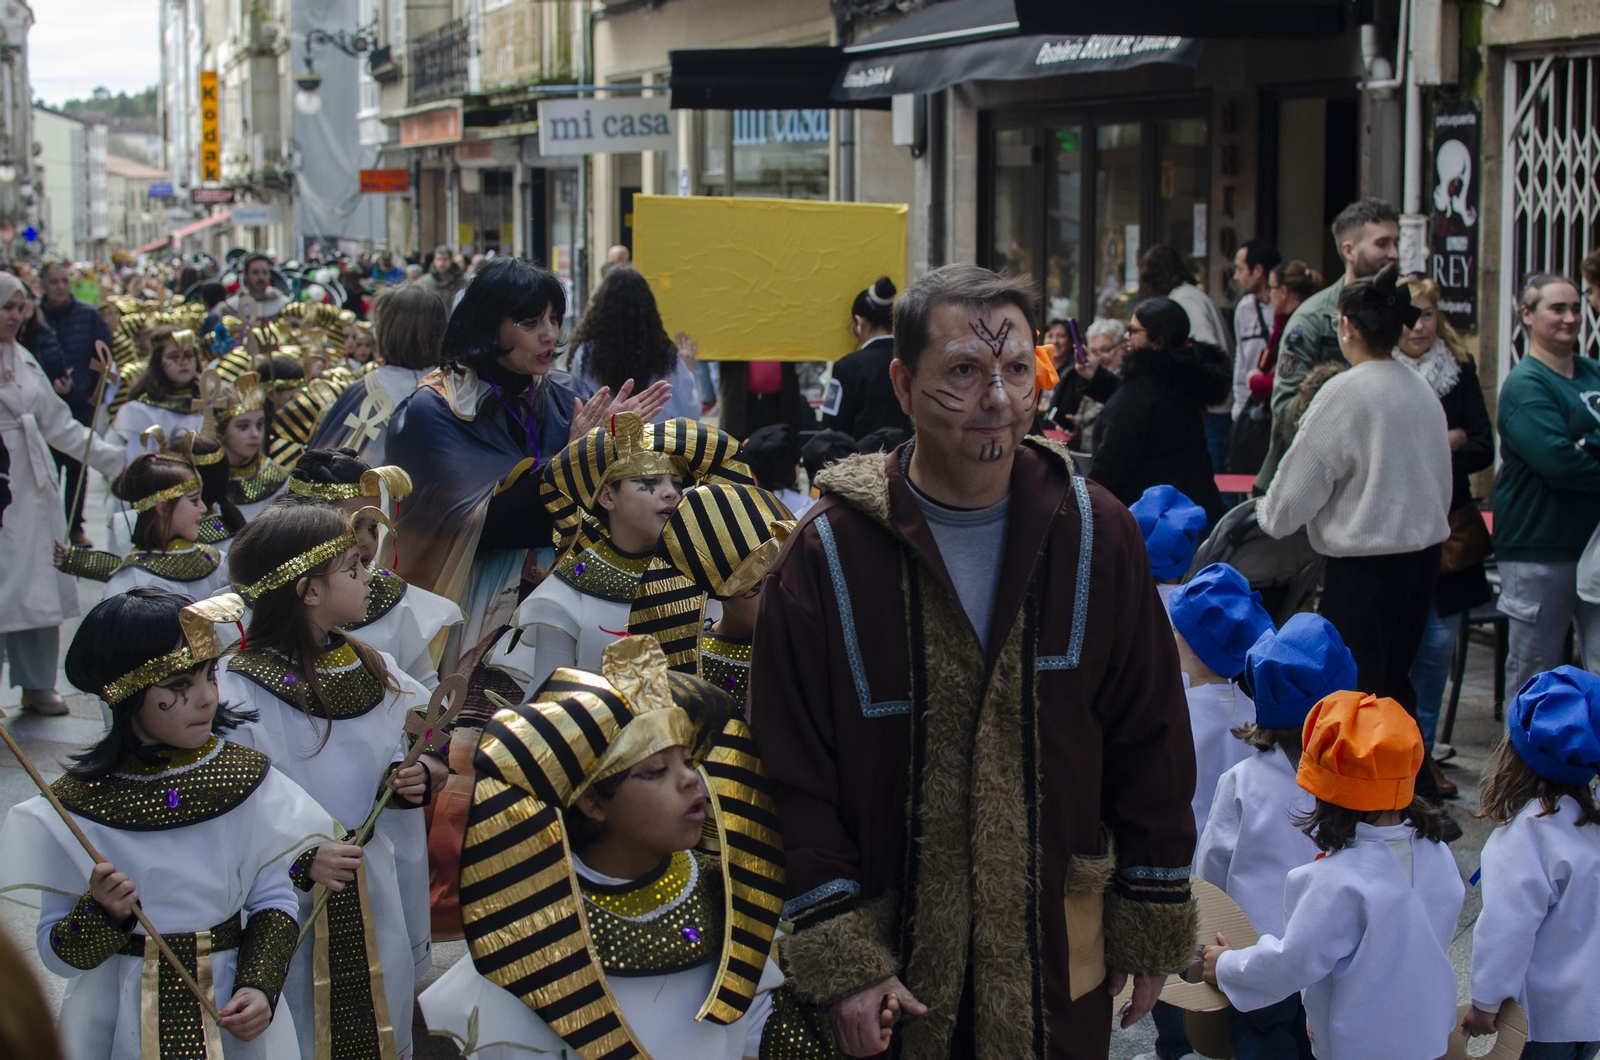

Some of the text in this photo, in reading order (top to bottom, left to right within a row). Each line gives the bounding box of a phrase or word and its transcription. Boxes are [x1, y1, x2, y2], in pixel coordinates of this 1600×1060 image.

[202, 86, 216, 180] Kodak
[549, 109, 671, 141] mi casa
[1432, 254, 1473, 289] REY
[1436, 299, 1473, 315] eluquería
